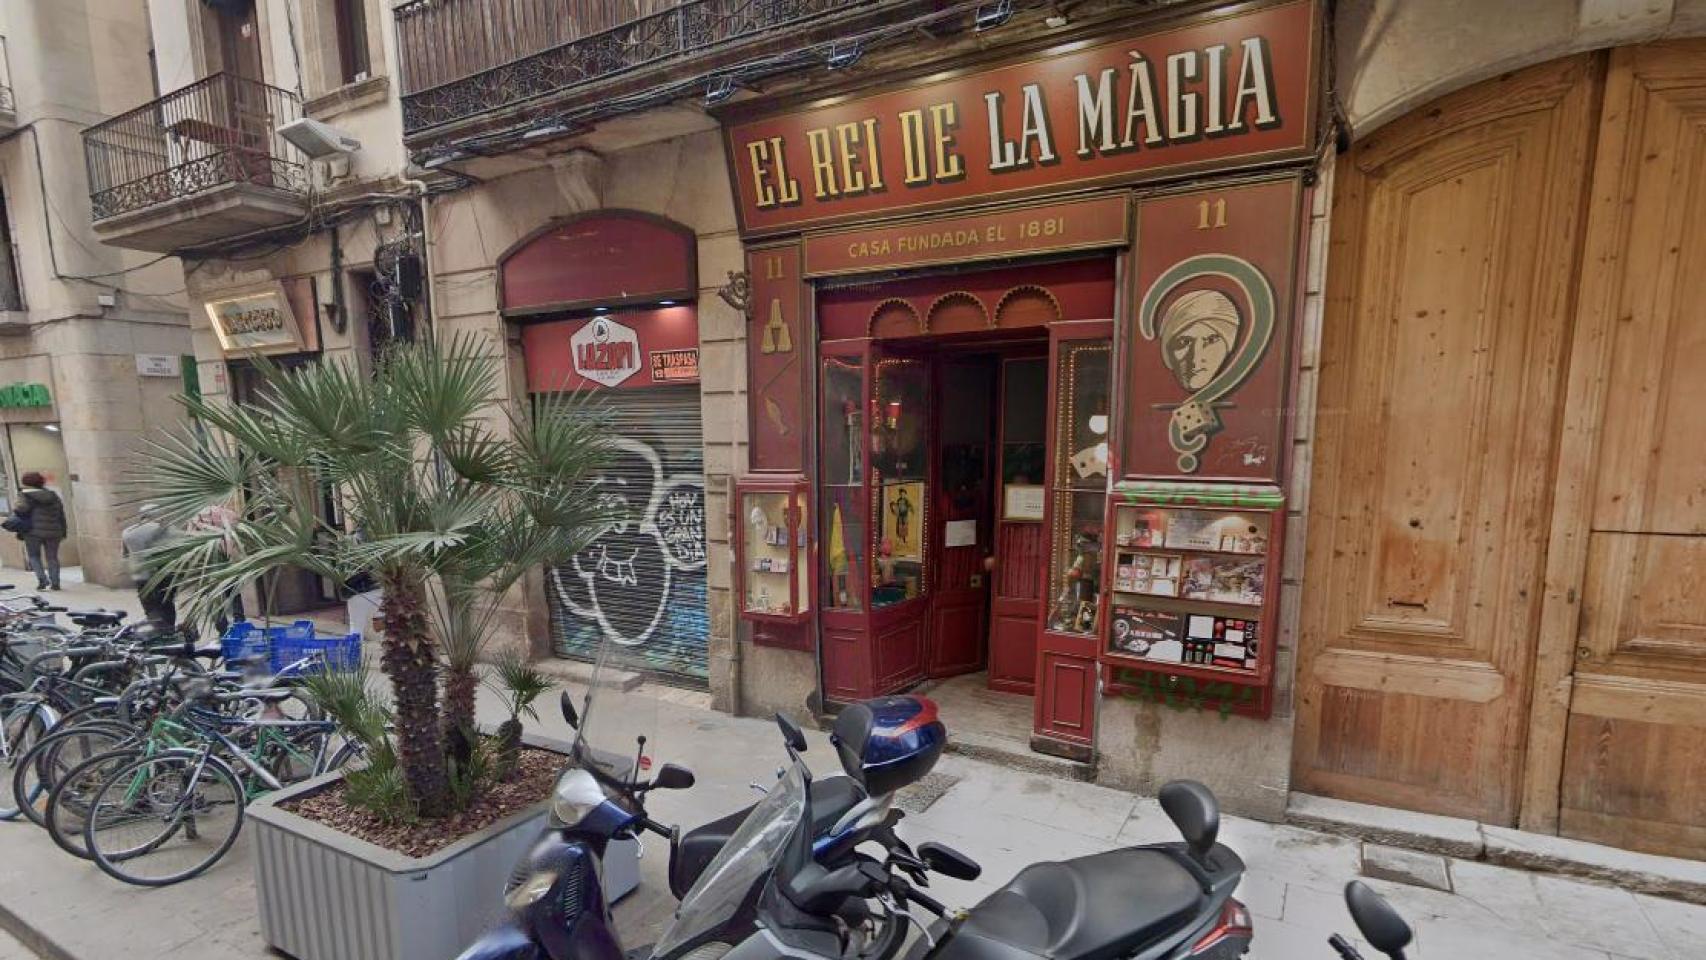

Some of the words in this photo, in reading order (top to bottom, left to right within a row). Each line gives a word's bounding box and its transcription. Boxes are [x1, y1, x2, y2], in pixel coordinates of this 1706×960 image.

[747, 137, 799, 207] EL
[806, 118, 884, 198] REI
[898, 102, 963, 185] DE
[984, 83, 1057, 170] LA
[1073, 36, 1278, 155] MÀGIA
[1196, 198, 1228, 230] 11
[849, 240, 891, 258] CASA
[898, 229, 980, 251] FUNDADA
[986, 226, 1006, 242] EL
[1019, 217, 1065, 239] 1881
